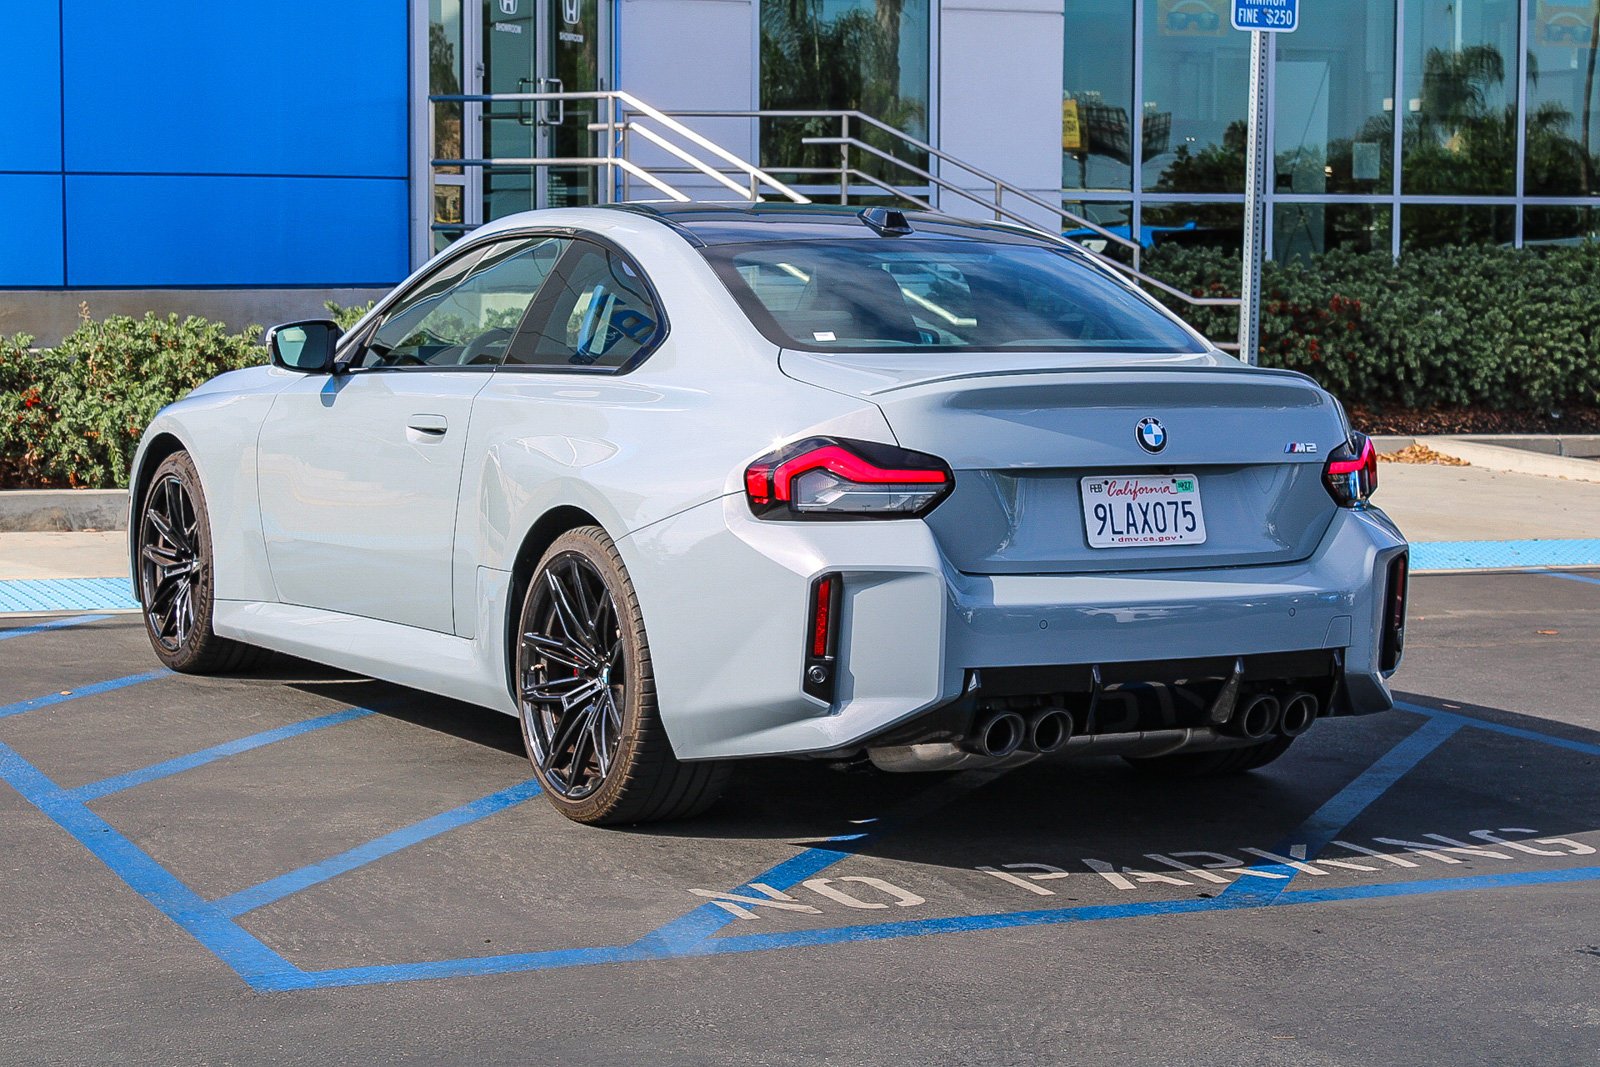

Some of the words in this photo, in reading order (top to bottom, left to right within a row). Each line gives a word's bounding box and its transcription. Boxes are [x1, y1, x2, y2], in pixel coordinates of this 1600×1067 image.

[1238, 8, 1259, 23] FINE
[1265, 9, 1293, 25] $250
[1293, 442, 1317, 453] M2
[1089, 483, 1103, 493] FEB
[1107, 480, 1178, 501] California
[1093, 501, 1197, 536] 9LAX075
[1118, 535, 1177, 543] dmv.ca.gov
[688, 876, 926, 920] NO
[975, 827, 1597, 896] PARKING
